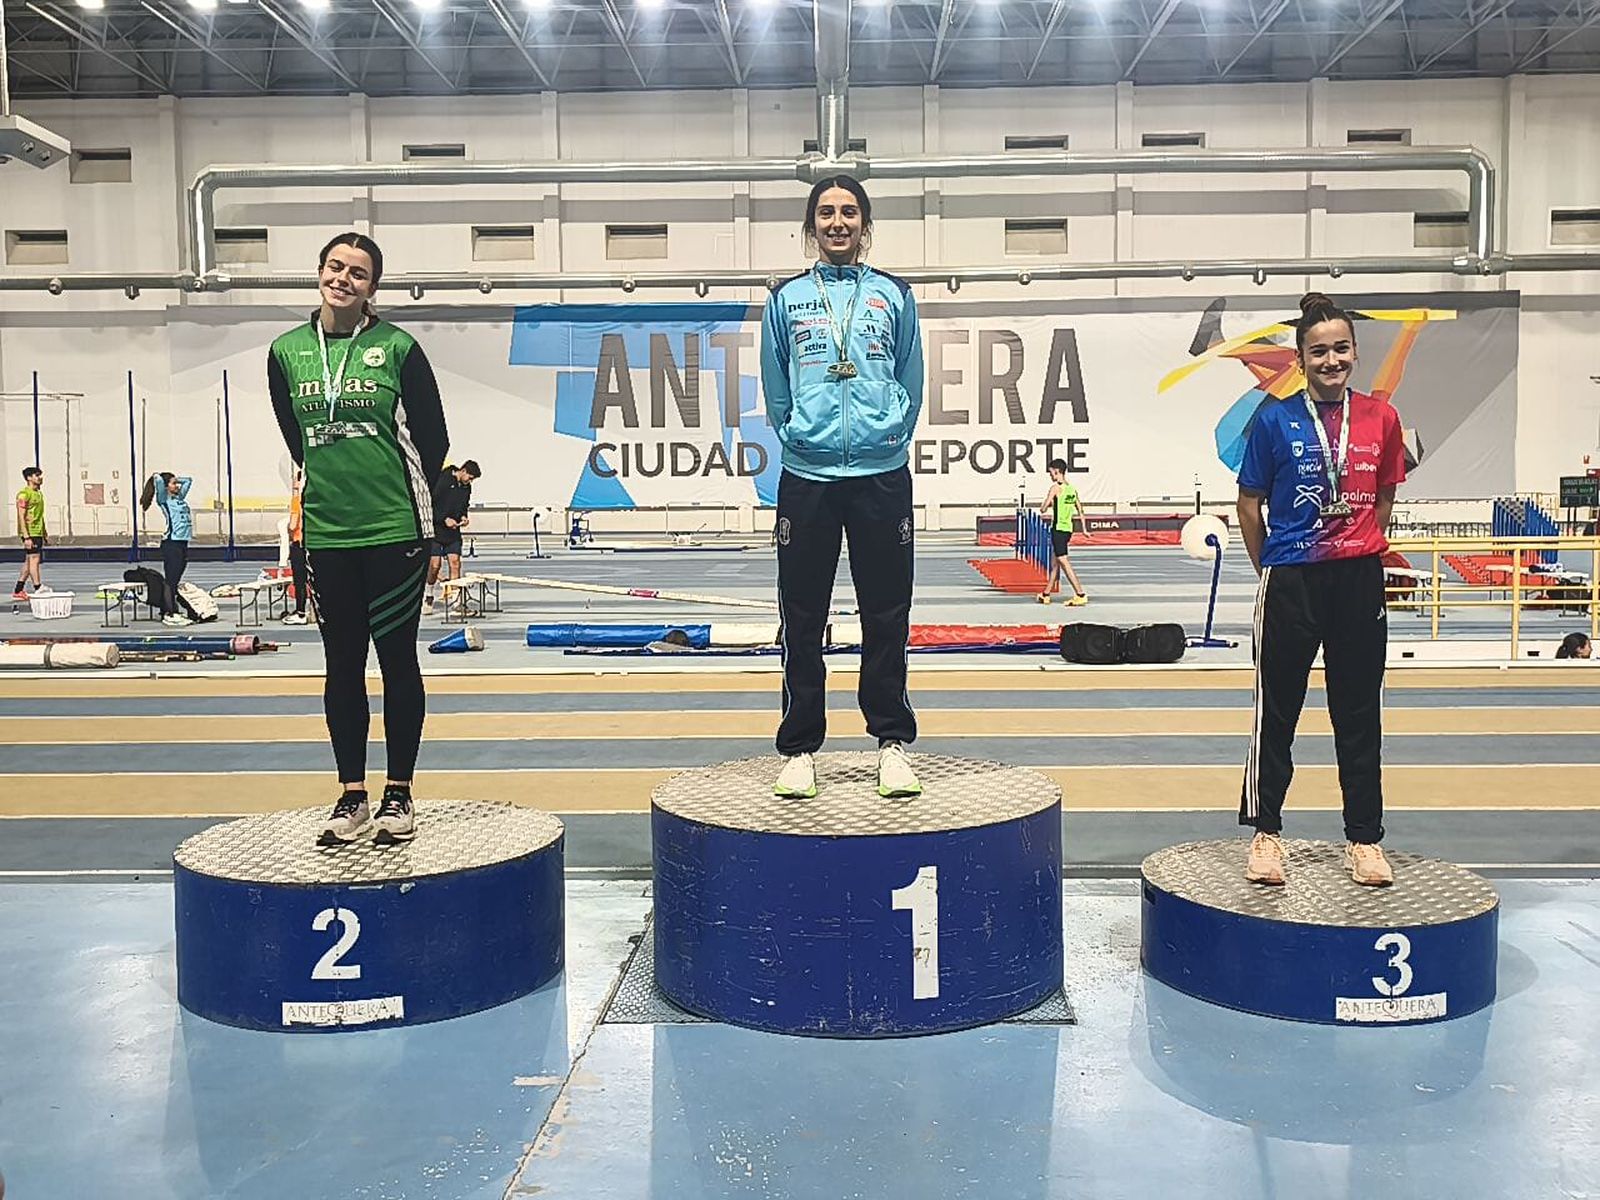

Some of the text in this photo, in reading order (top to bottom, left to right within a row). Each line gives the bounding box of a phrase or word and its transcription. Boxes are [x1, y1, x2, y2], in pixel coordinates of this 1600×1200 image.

[589, 438, 1090, 477] CIUDAD EPORTE
[1090, 521, 1120, 529] DIMA
[311, 908, 361, 980] 2
[892, 866, 940, 1000] 1
[1372, 933, 1413, 996] 3
